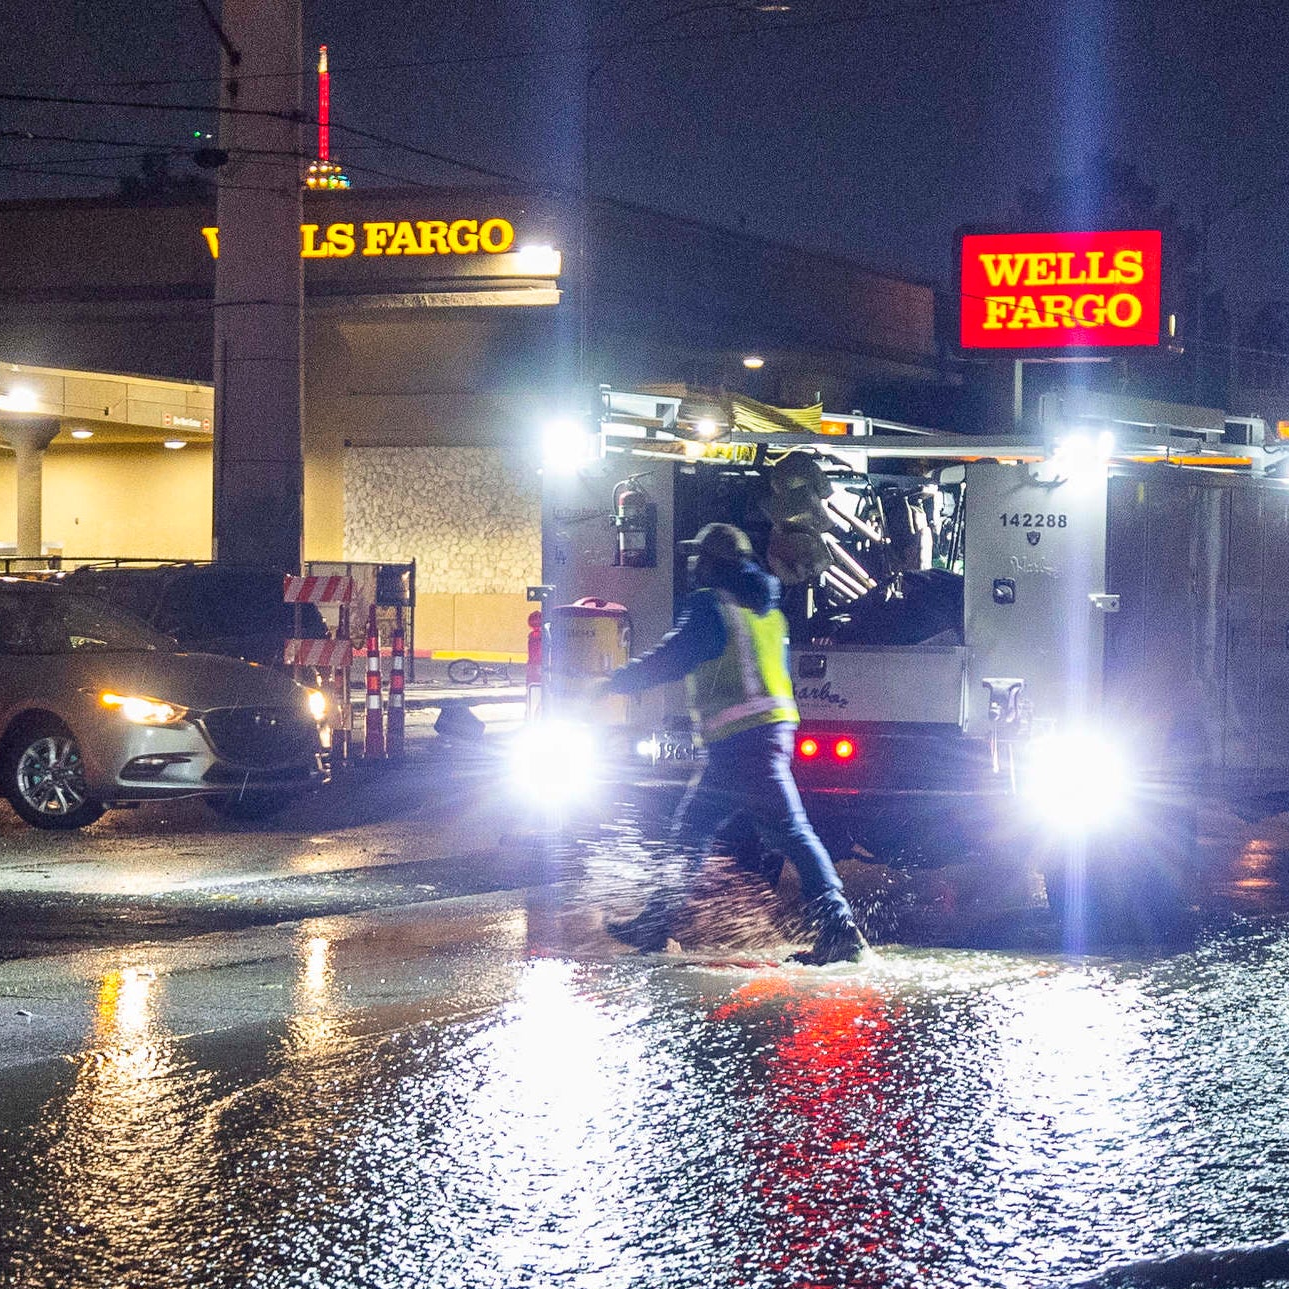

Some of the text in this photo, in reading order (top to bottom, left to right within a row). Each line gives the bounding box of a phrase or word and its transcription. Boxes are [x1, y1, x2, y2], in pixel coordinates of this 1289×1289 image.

[362, 218, 515, 256] FARGO
[979, 250, 1144, 286] WELLS
[983, 293, 1143, 329] FARGO
[1000, 513, 1068, 528] 142288
